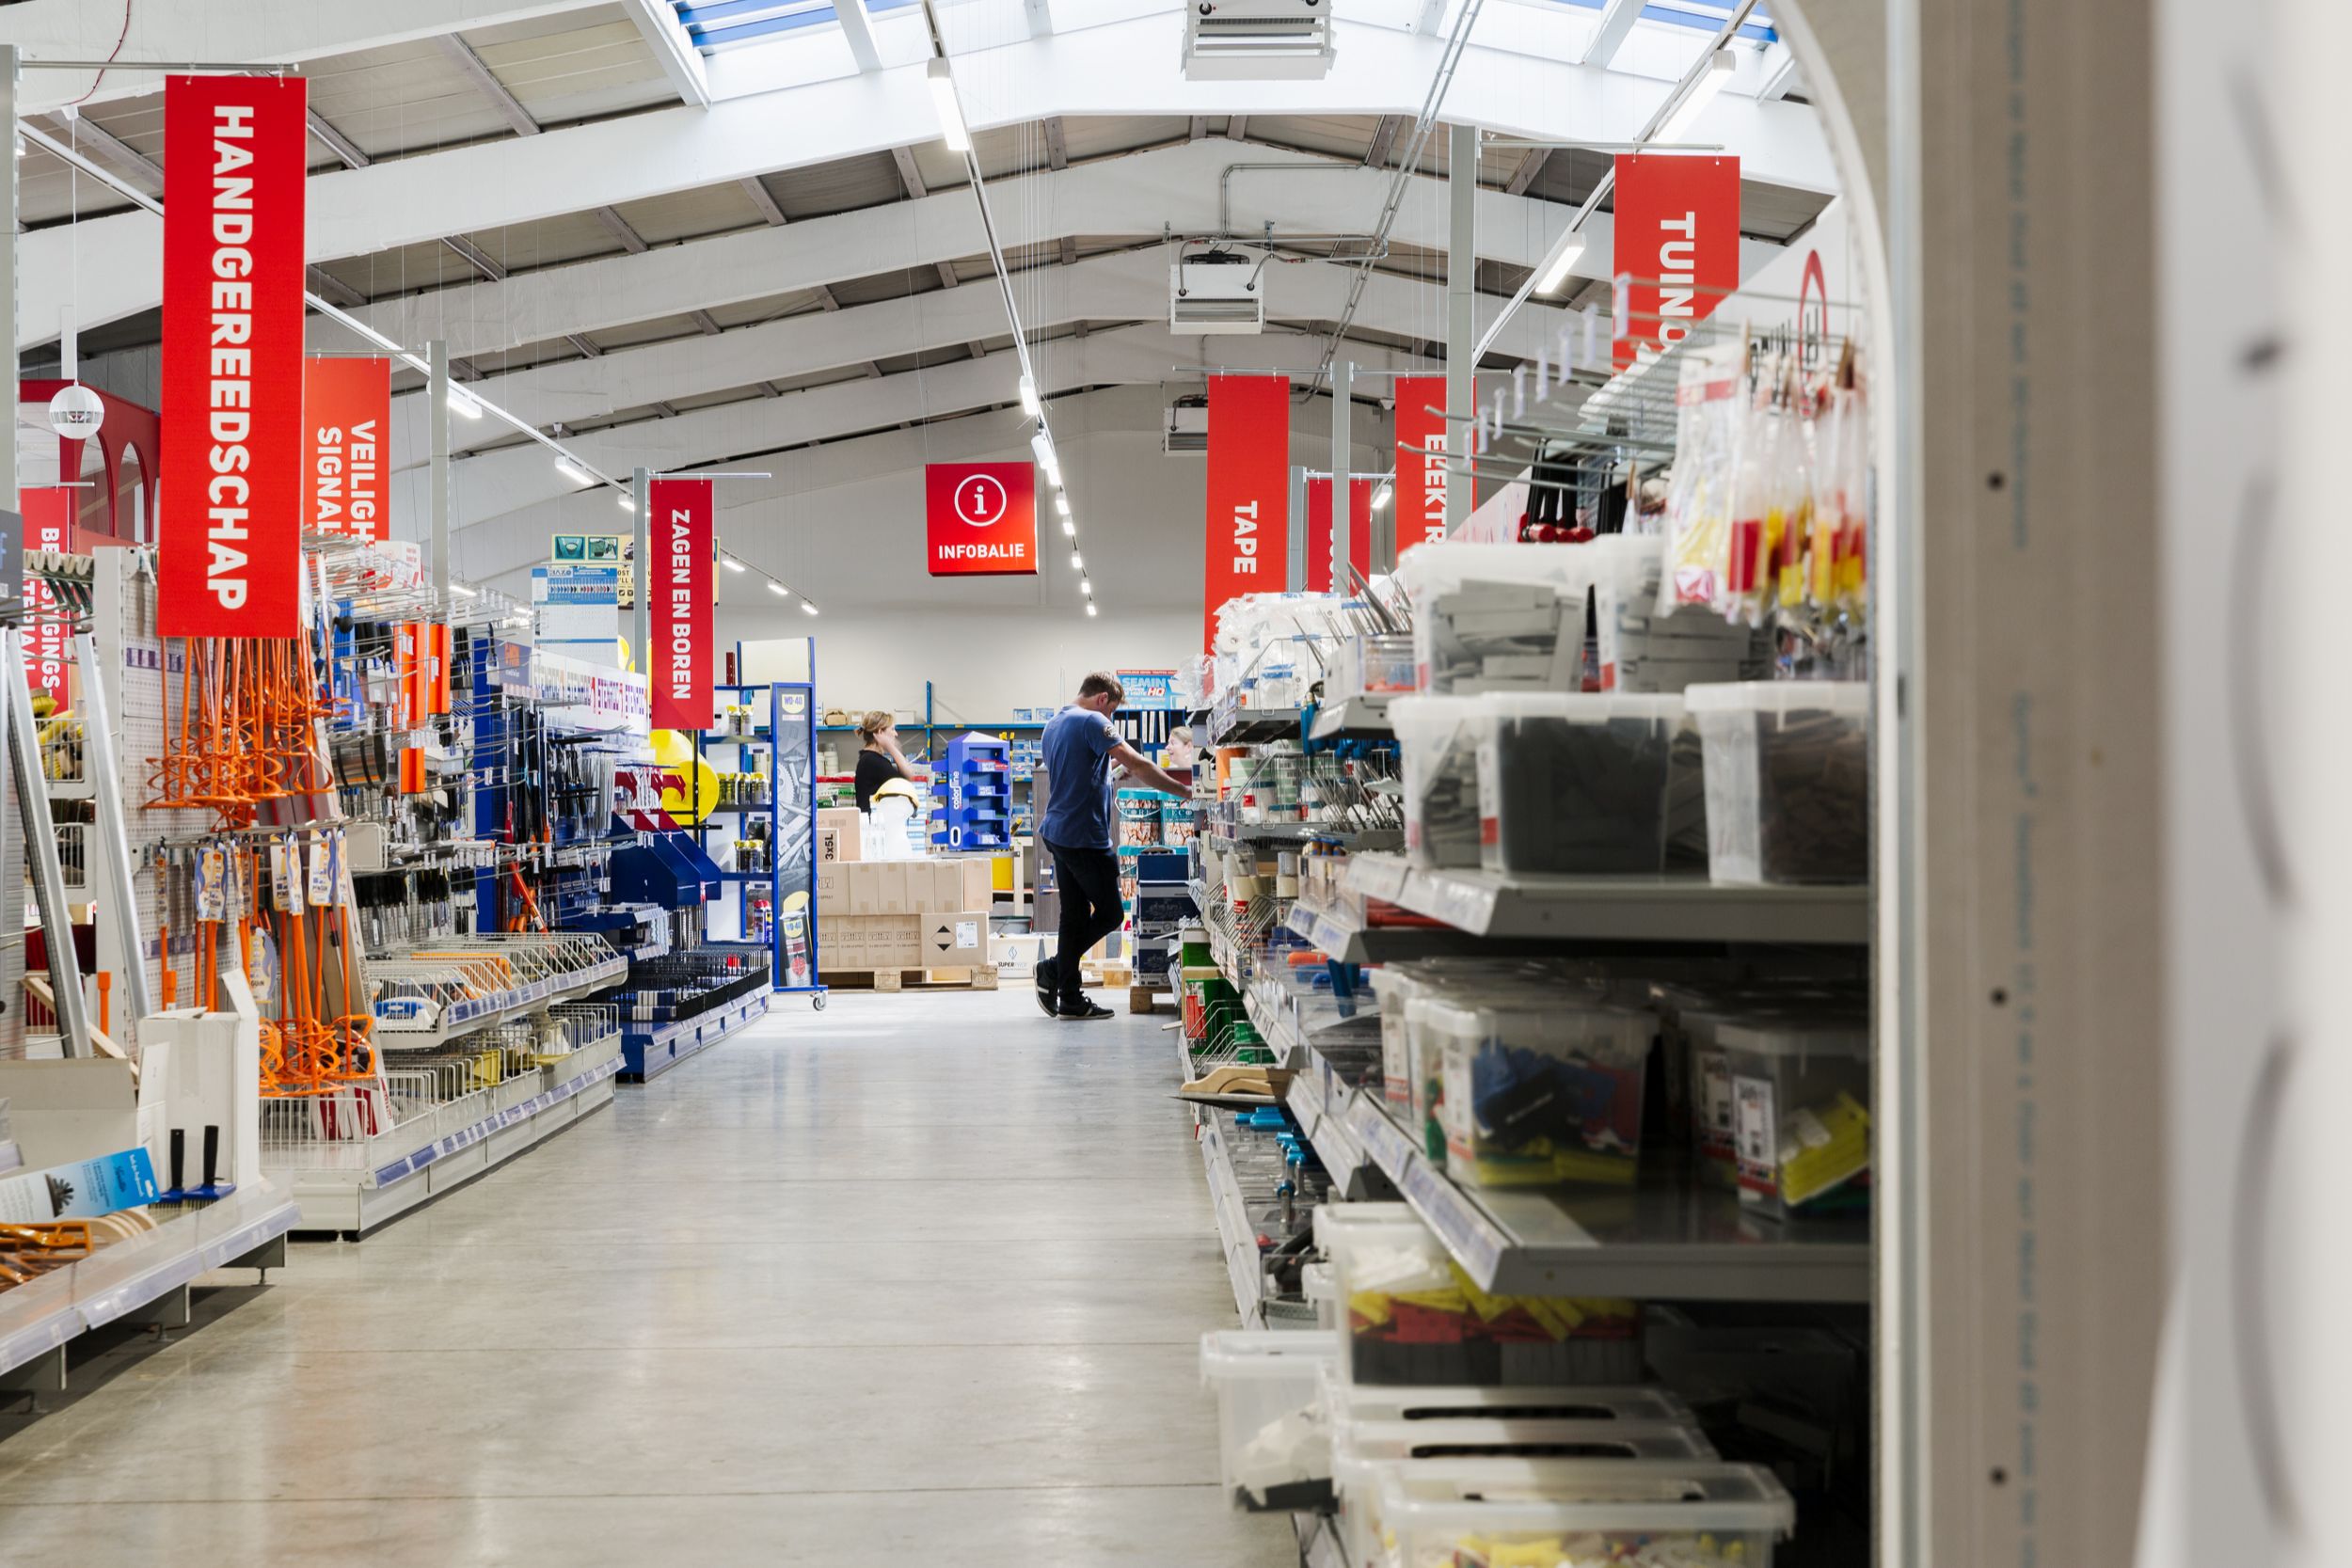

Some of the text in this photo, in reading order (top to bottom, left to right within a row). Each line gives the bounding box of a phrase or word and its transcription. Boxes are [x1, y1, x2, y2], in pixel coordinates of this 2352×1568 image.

[207, 105, 254, 610] HANDGEREEDSCHAP
[938, 543, 1025, 559] INFOBALIE
[1233, 500, 1258, 574] TAPE
[672, 509, 691, 699] ZAGEN EN BOREN
[1121, 677, 1167, 688] SEMIN
[824, 833, 834, 861] 3x5L
